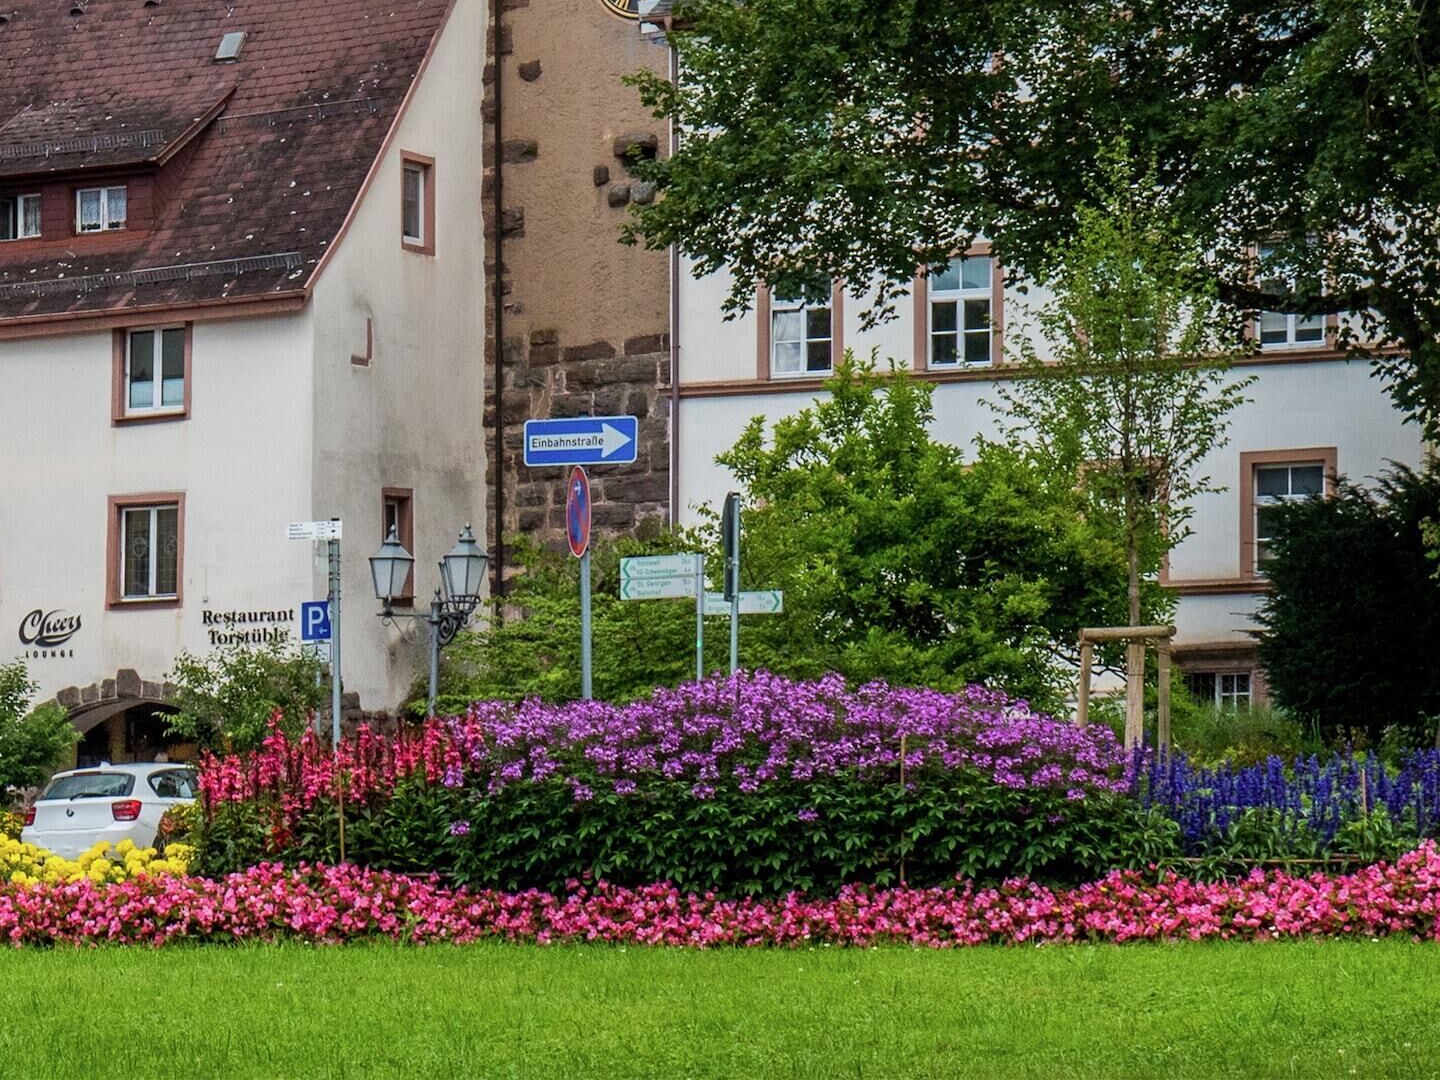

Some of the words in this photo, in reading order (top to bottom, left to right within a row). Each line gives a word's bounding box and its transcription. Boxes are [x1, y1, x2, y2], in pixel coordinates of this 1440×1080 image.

[531, 435, 605, 449] Einbahnstraße
[202, 608, 295, 625] Restaurant
[308, 606, 324, 636] P
[19, 609, 82, 648] Cheers
[208, 627, 290, 645] Torstüble
[25, 649, 74, 659] LOUNGE
